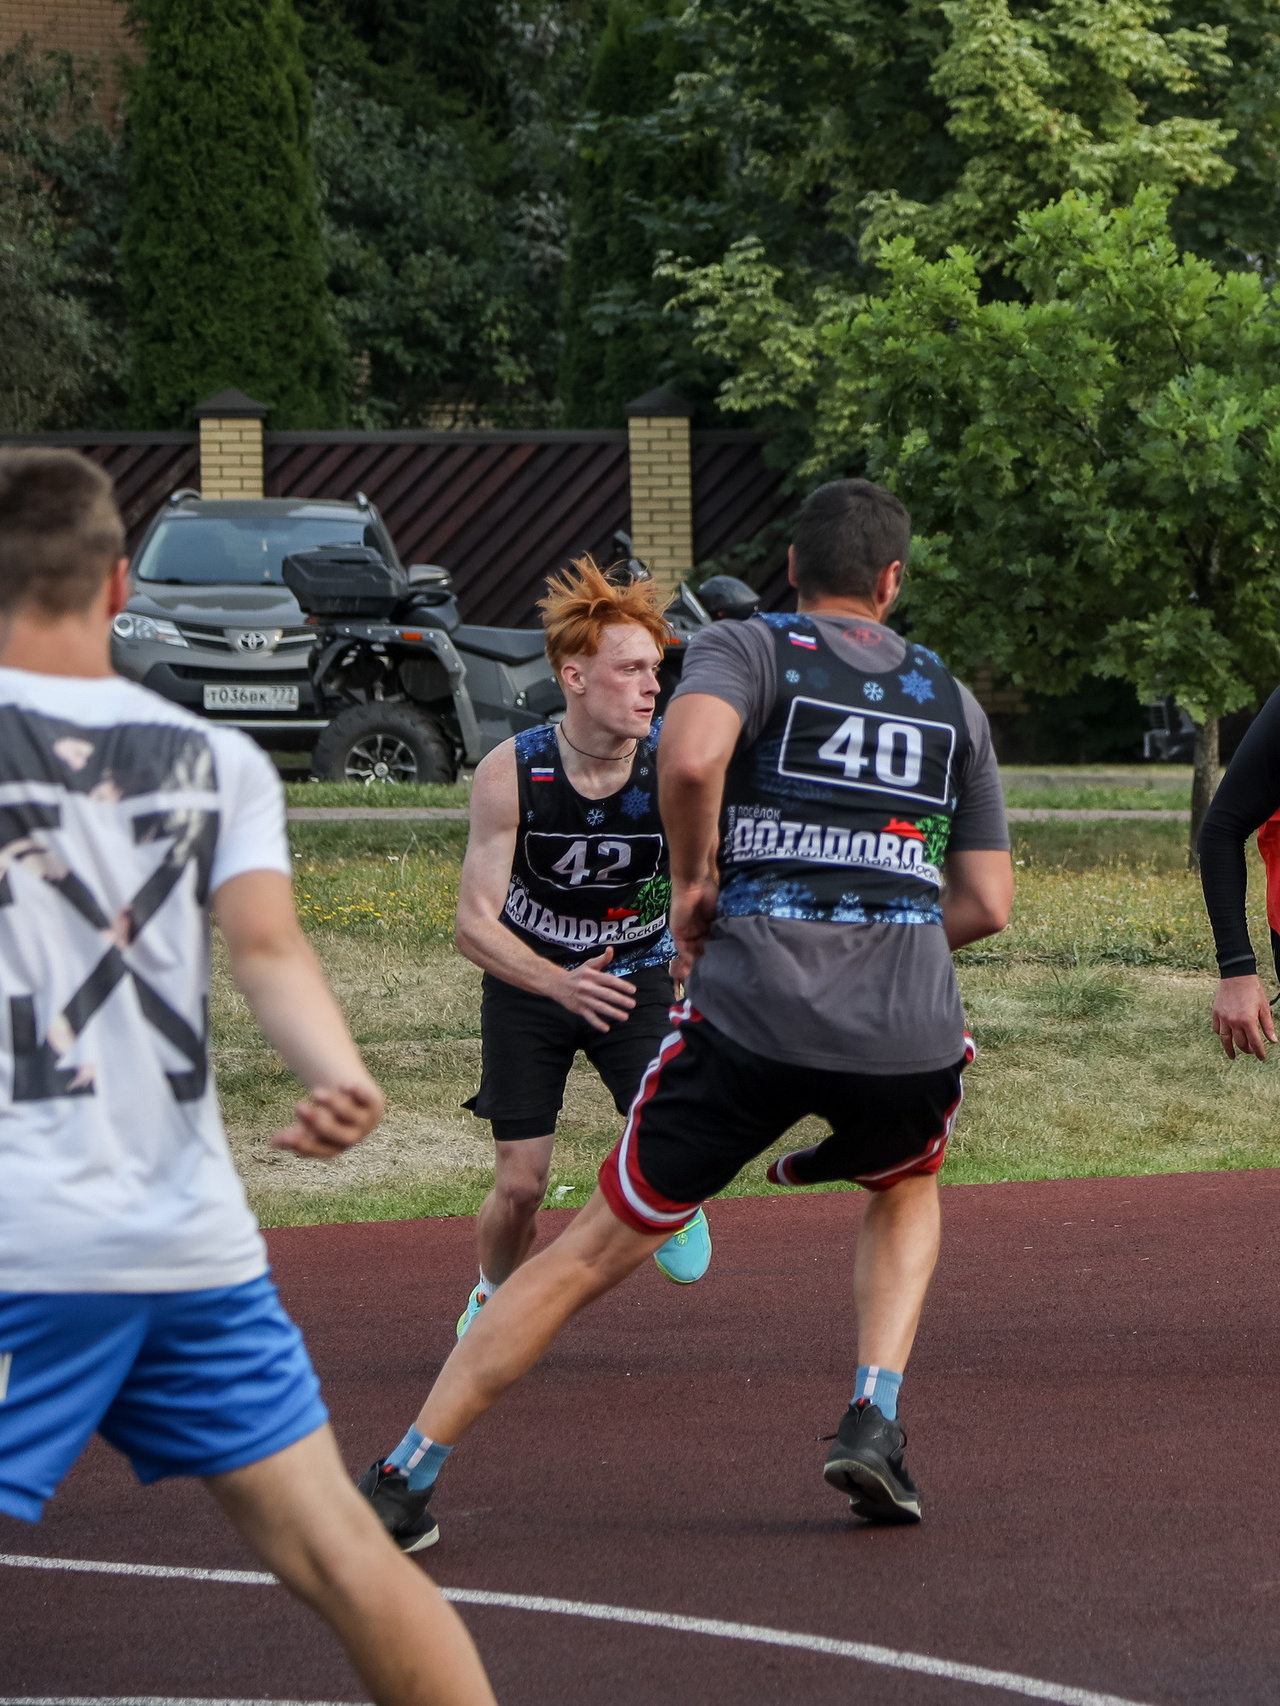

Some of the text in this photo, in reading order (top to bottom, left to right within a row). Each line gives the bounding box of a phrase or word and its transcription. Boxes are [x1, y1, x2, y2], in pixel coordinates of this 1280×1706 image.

[817, 714, 923, 787] 40
[737, 804, 781, 820] посёлок
[550, 840, 632, 885] 42
[732, 818, 924, 866] ПОТАПОВО
[611, 919, 664, 942] Москва
